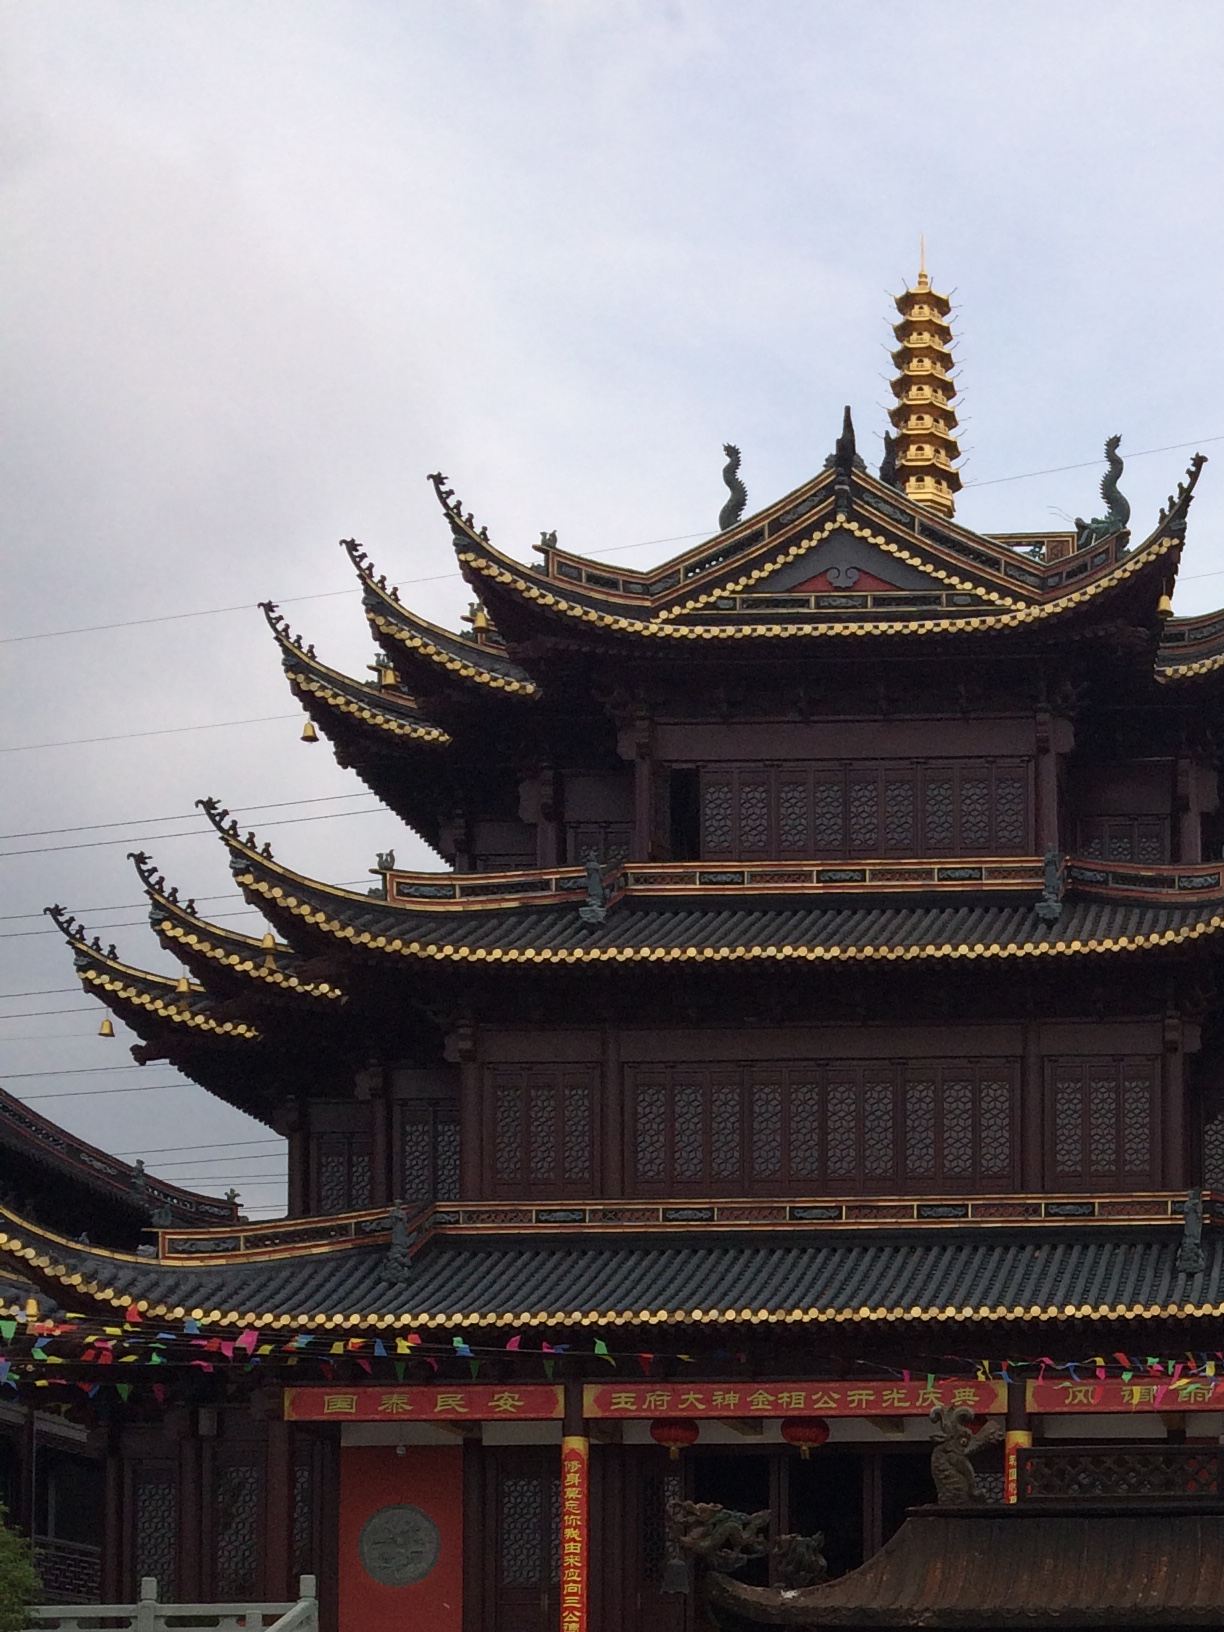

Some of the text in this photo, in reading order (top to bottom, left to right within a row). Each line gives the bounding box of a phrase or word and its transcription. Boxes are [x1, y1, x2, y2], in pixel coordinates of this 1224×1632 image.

[323, 1391, 524, 1414] 国泰民安
[609, 1387, 981, 1411] 玉府大神金相公开光庆典
